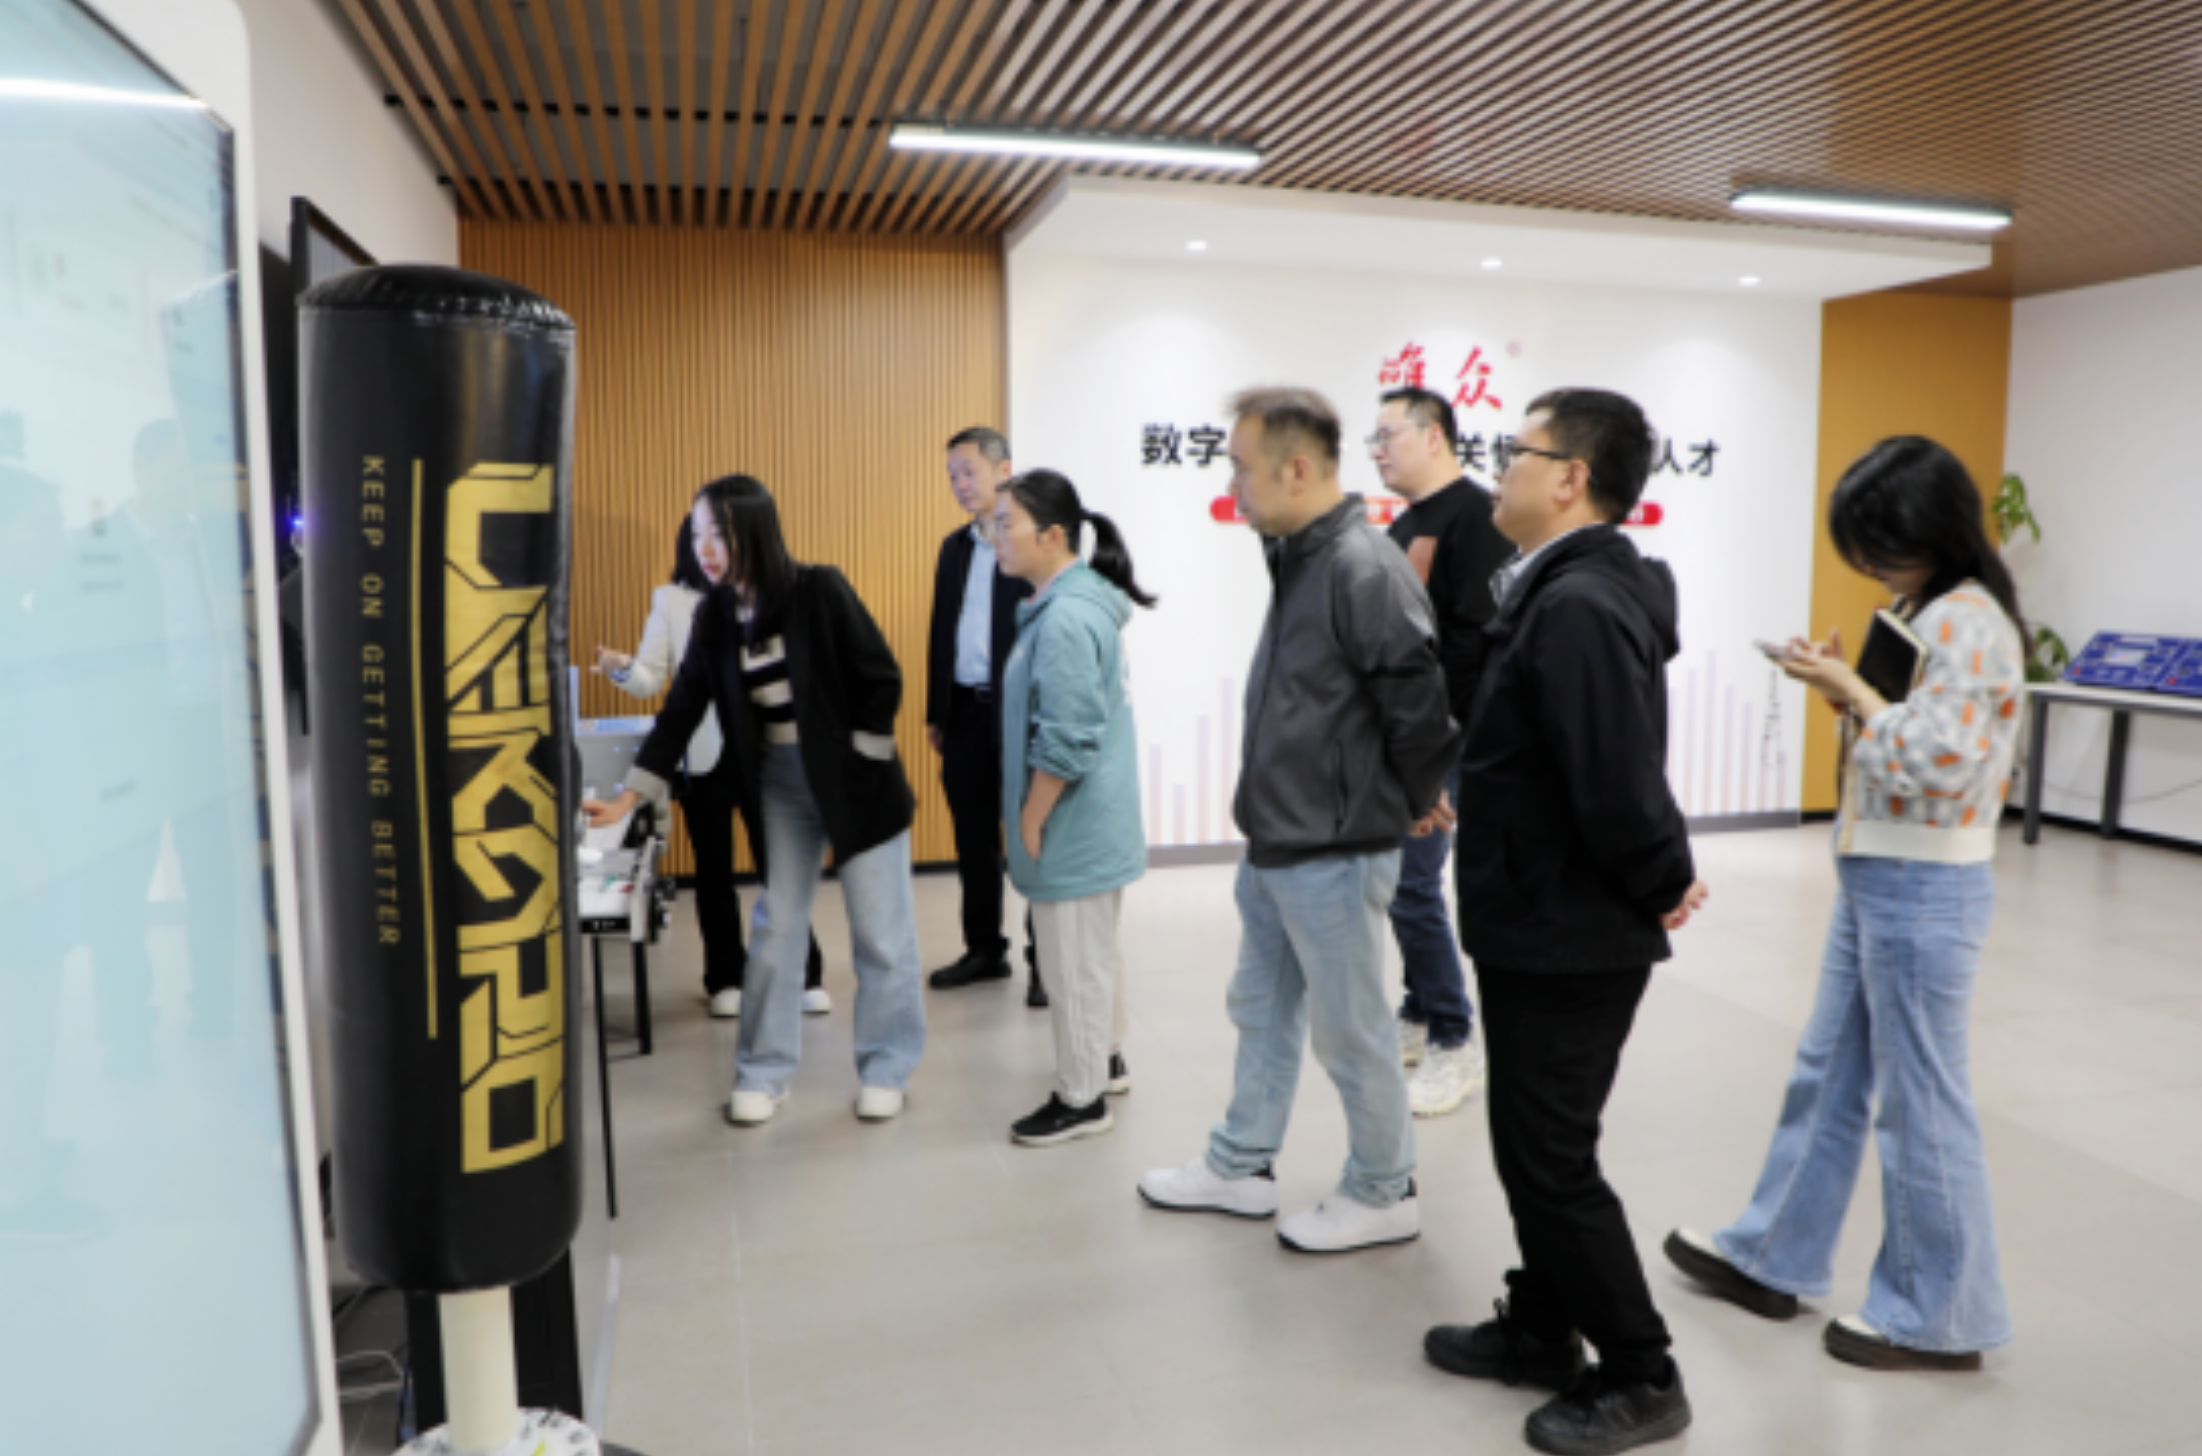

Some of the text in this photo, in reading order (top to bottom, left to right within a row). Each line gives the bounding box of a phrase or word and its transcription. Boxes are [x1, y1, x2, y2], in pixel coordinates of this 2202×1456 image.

[1141, 423, 1228, 466] 数字
[1651, 437, 1720, 477] 人才
[361, 455, 400, 945] KEEP ON GETTING BETTER
